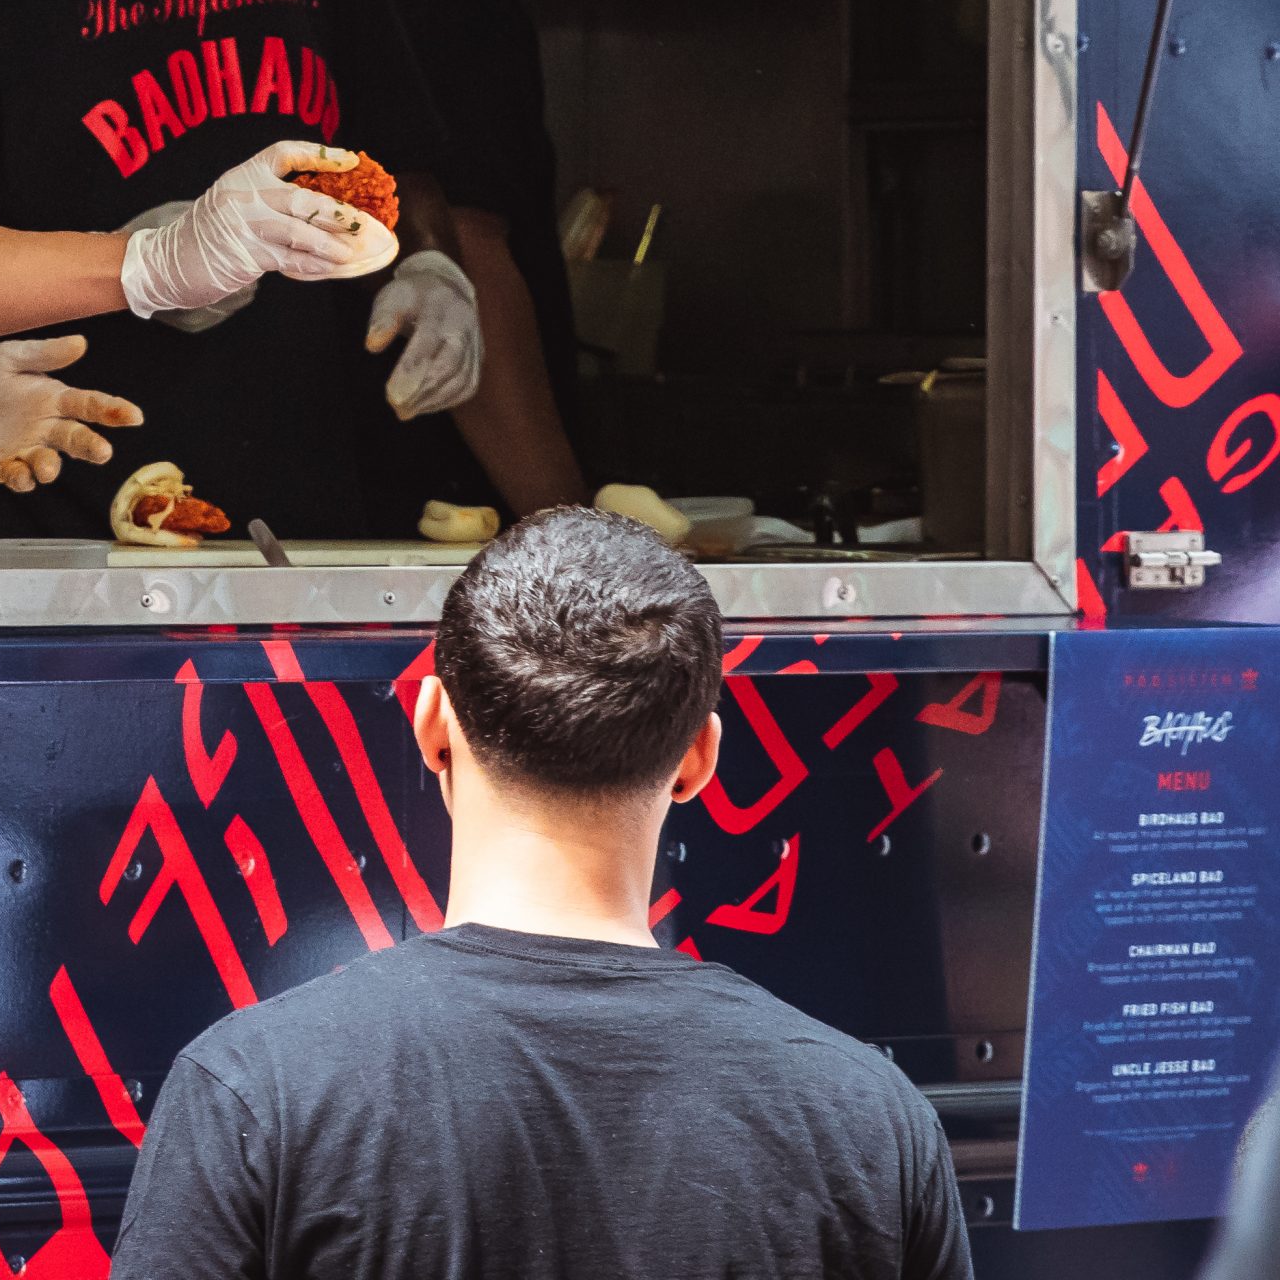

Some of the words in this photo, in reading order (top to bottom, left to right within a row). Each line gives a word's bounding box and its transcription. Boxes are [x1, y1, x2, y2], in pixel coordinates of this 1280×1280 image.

[1157, 772, 1211, 791] MENU
[1131, 871, 1197, 886] SPICELAND
[1128, 943, 1190, 957] CHAIRMAN
[1122, 1002, 1158, 1016] FRIED
[1160, 1001, 1188, 1015] FISH
[1112, 1062, 1151, 1076] UNCLE
[1153, 1060, 1189, 1074] JESSE
